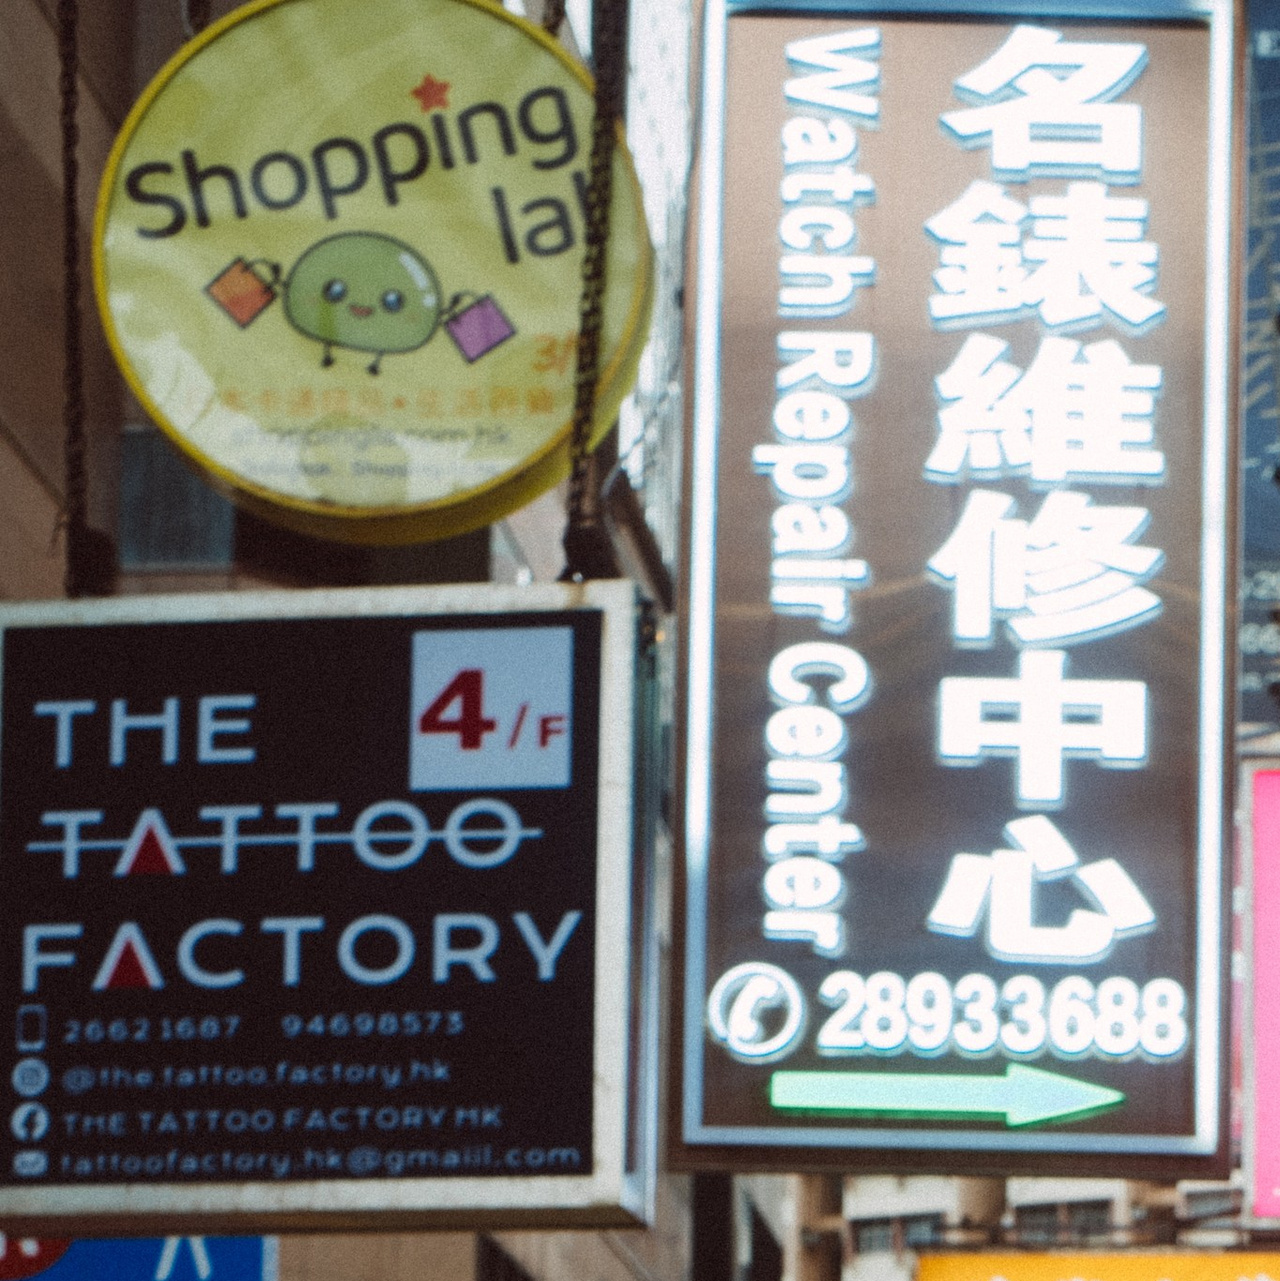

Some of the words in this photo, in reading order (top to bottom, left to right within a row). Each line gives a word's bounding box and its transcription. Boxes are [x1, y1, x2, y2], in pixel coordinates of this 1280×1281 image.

[124, 86, 580, 239] Shopping
[781, 28, 882, 318] Watch
[753, 330, 875, 633] Repair
[924, 24, 1168, 964] 名錶維修中心
[34, 694, 258, 769] THE
[417, 668, 568, 751] 4/F
[764, 642, 870, 956] Center
[22, 910, 583, 992] FACTORY
[818, 971, 1189, 1059] 28933688
